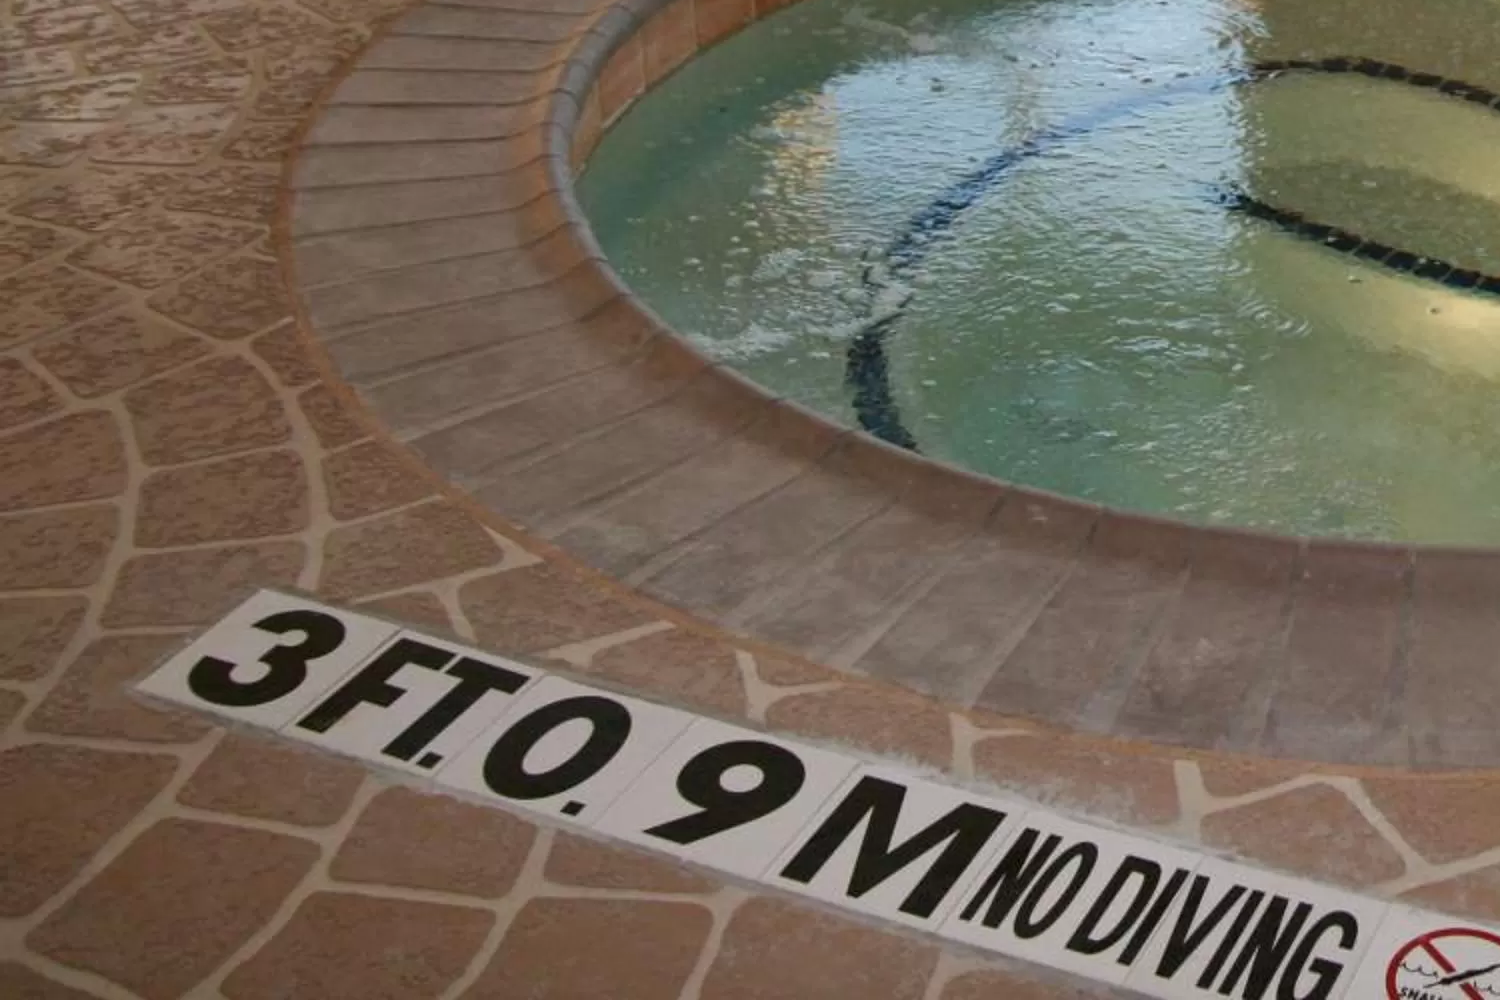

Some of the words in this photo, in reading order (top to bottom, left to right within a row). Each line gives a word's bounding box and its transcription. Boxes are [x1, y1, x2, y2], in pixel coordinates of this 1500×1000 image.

[187, 609, 346, 708] 3
[779, 774, 1009, 920] M
[958, 826, 1099, 941] NO
[1064, 854, 1359, 1000] DIVING
